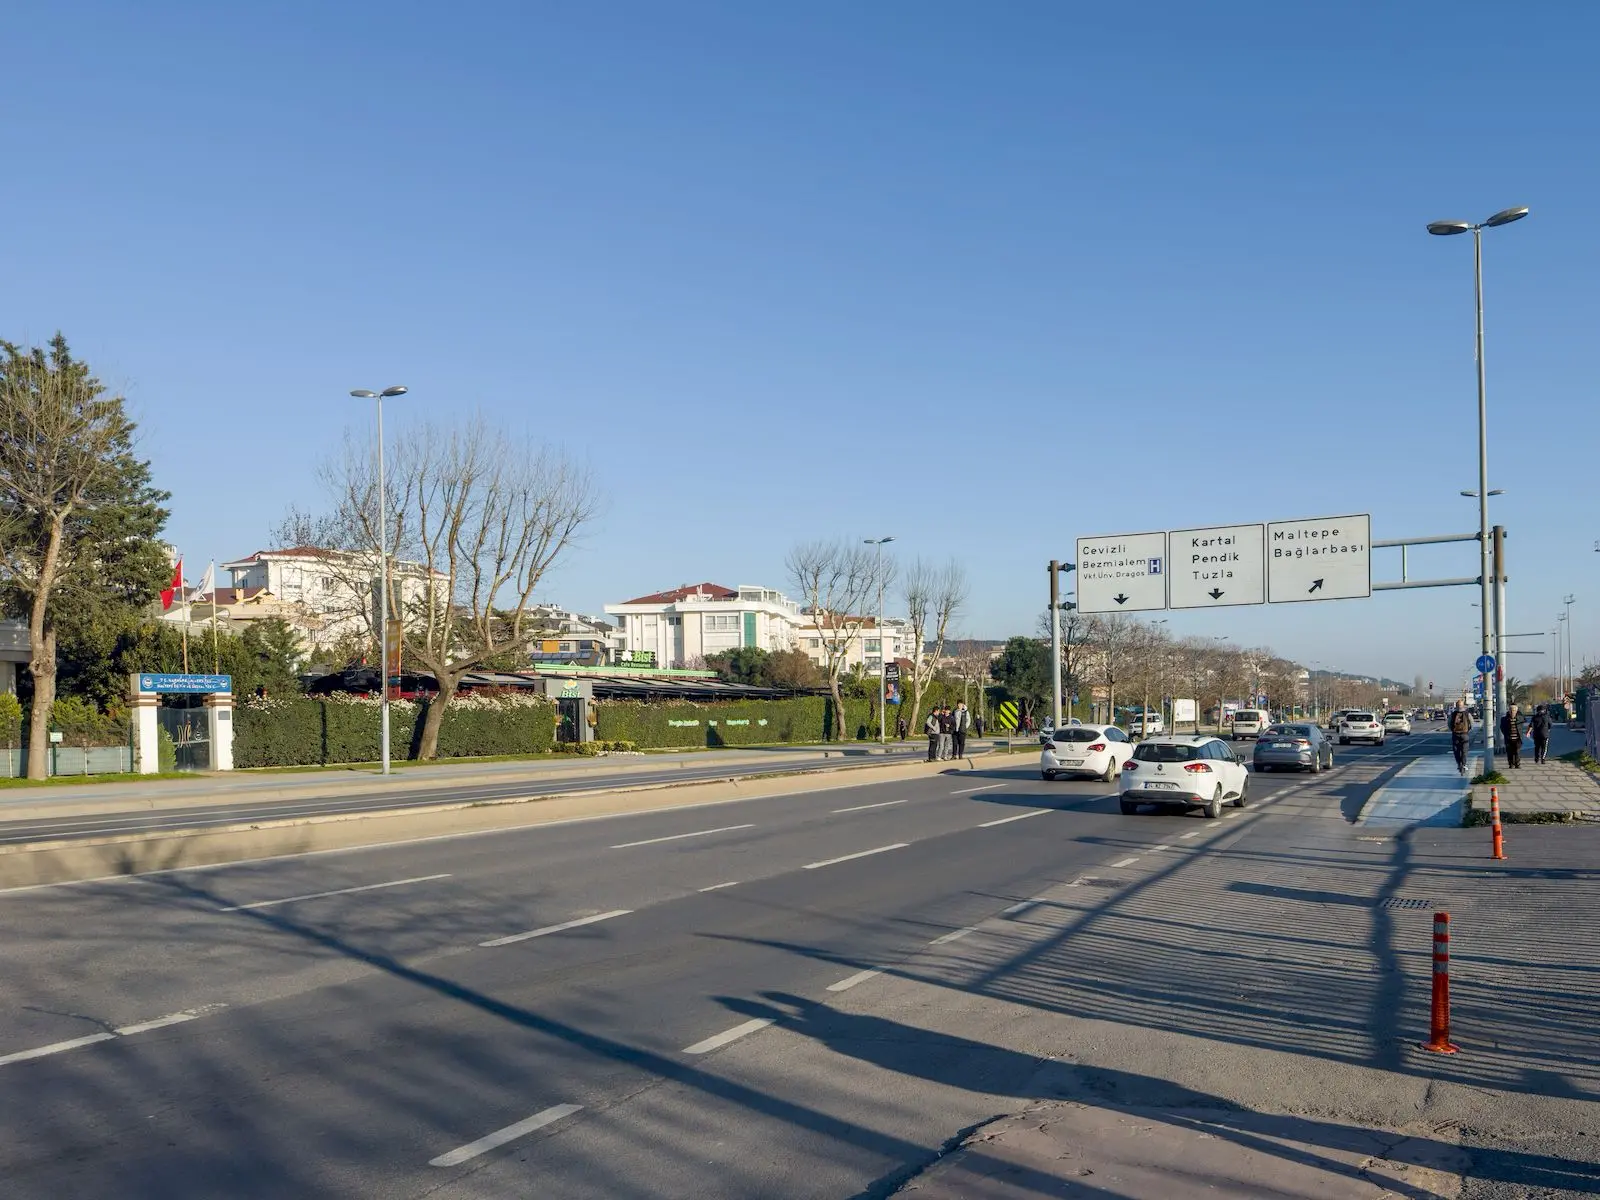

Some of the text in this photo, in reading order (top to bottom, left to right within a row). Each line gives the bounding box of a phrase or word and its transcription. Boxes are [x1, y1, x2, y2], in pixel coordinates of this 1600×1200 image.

[1274, 528, 1340, 540] Maltepe
[1192, 535, 1236, 547] Kartal
[1082, 545, 1126, 555] Cevizli
[1274, 544, 1364, 558] Bağlarbaşı
[1082, 558, 1146, 569] Bezmialem
[1192, 552, 1239, 564] Pendik
[1150, 559, 1161, 573] H
[1192, 569, 1233, 580] Tuzla
